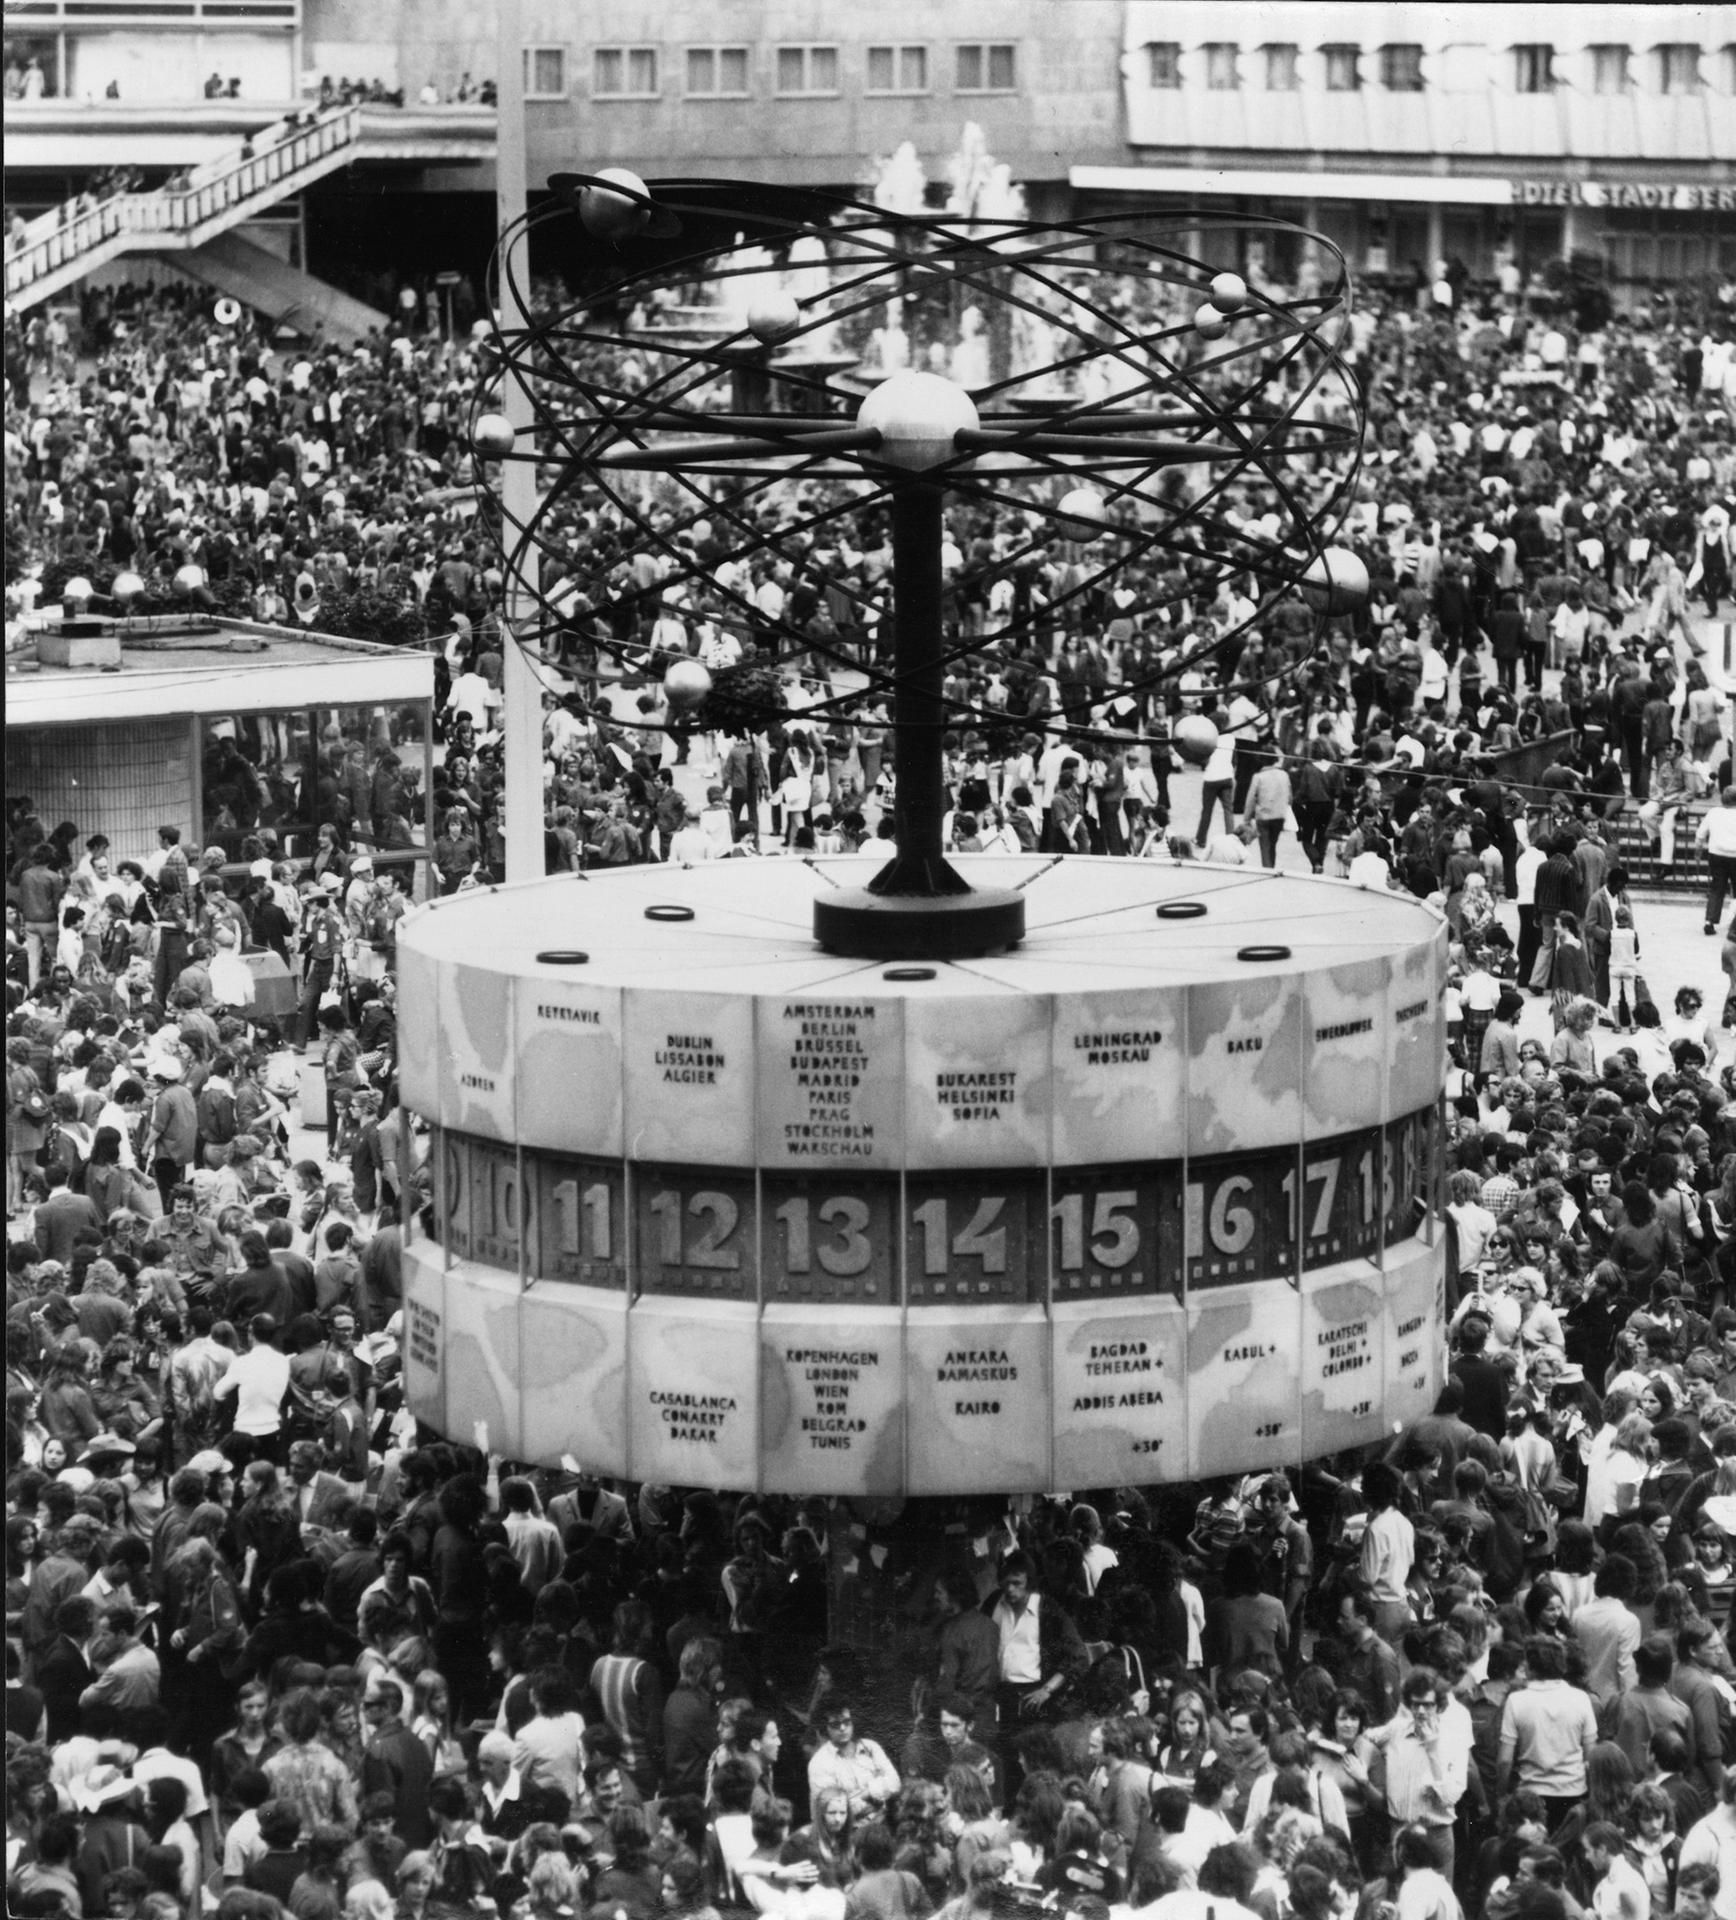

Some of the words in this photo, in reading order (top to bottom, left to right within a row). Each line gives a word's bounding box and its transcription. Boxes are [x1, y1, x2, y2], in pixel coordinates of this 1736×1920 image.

[784, 1005, 874, 1018] AMSTERDAM
[802, 1023, 856, 1035] BERLIN
[1316, 1019, 1372, 1042] SWERDLOWSK
[668, 1035, 712, 1049] DUBLIN
[796, 1038, 863, 1053] BRÜSSEL
[1075, 1031, 1161, 1048] LENINGRAD
[1228, 1038, 1262, 1053] BAKU
[656, 1052, 724, 1067] LISSABON
[791, 1057, 868, 1069] BUDAPEST
[1088, 1049, 1149, 1064] MOSKAU
[458, 1075, 494, 1091] AZOREN
[664, 1069, 715, 1084] ALGIER
[799, 1074, 859, 1086] MADRID
[937, 1072, 1016, 1087] BUKAREST
[810, 1091, 850, 1104] PARIS
[939, 1090, 1014, 1103] HELSINKI
[810, 1108, 849, 1121] PRAG
[954, 1107, 999, 1120] SOFIA
[785, 1125, 873, 1138] STOCKHOLM
[788, 1142, 871, 1155] WARSCHAU
[1360, 1140, 1394, 1224] 18
[1282, 1157, 1342, 1243] 17
[553, 1179, 610, 1259] 11
[1177, 1175, 1256, 1258] 16
[650, 1190, 740, 1270] 12
[776, 1196, 872, 1276] 13
[912, 1197, 1007, 1275] 14
[1051, 1190, 1140, 1268] 15
[1318, 1322, 1367, 1346] KARATSCHI
[786, 1350, 878, 1365] KOPENHAGEN
[946, 1351, 1008, 1363] ANKARA
[1091, 1343, 1146, 1358] BAGDAD
[1225, 1346, 1264, 1361] KABUL
[1330, 1342, 1355, 1358] DELHI
[938, 1367, 1017, 1381] DAMASKUS
[1086, 1359, 1150, 1375] TEHERAN
[1323, 1356, 1363, 1377] COLOMBO
[806, 1369, 858, 1380] LONDON
[815, 1386, 848, 1397] WIEN
[650, 1392, 736, 1410] CASABLANCA
[817, 1403, 846, 1414] ROM
[956, 1402, 1000, 1414] KAIRO
[1074, 1396, 1114, 1410] ADDIS
[1119, 1392, 1162, 1406] ABEBA
[663, 1409, 724, 1424] CONAKRY
[802, 1418, 866, 1431] BELGRAD
[671, 1427, 716, 1442] DAKAR
[811, 1436, 850, 1449] TUNIS
